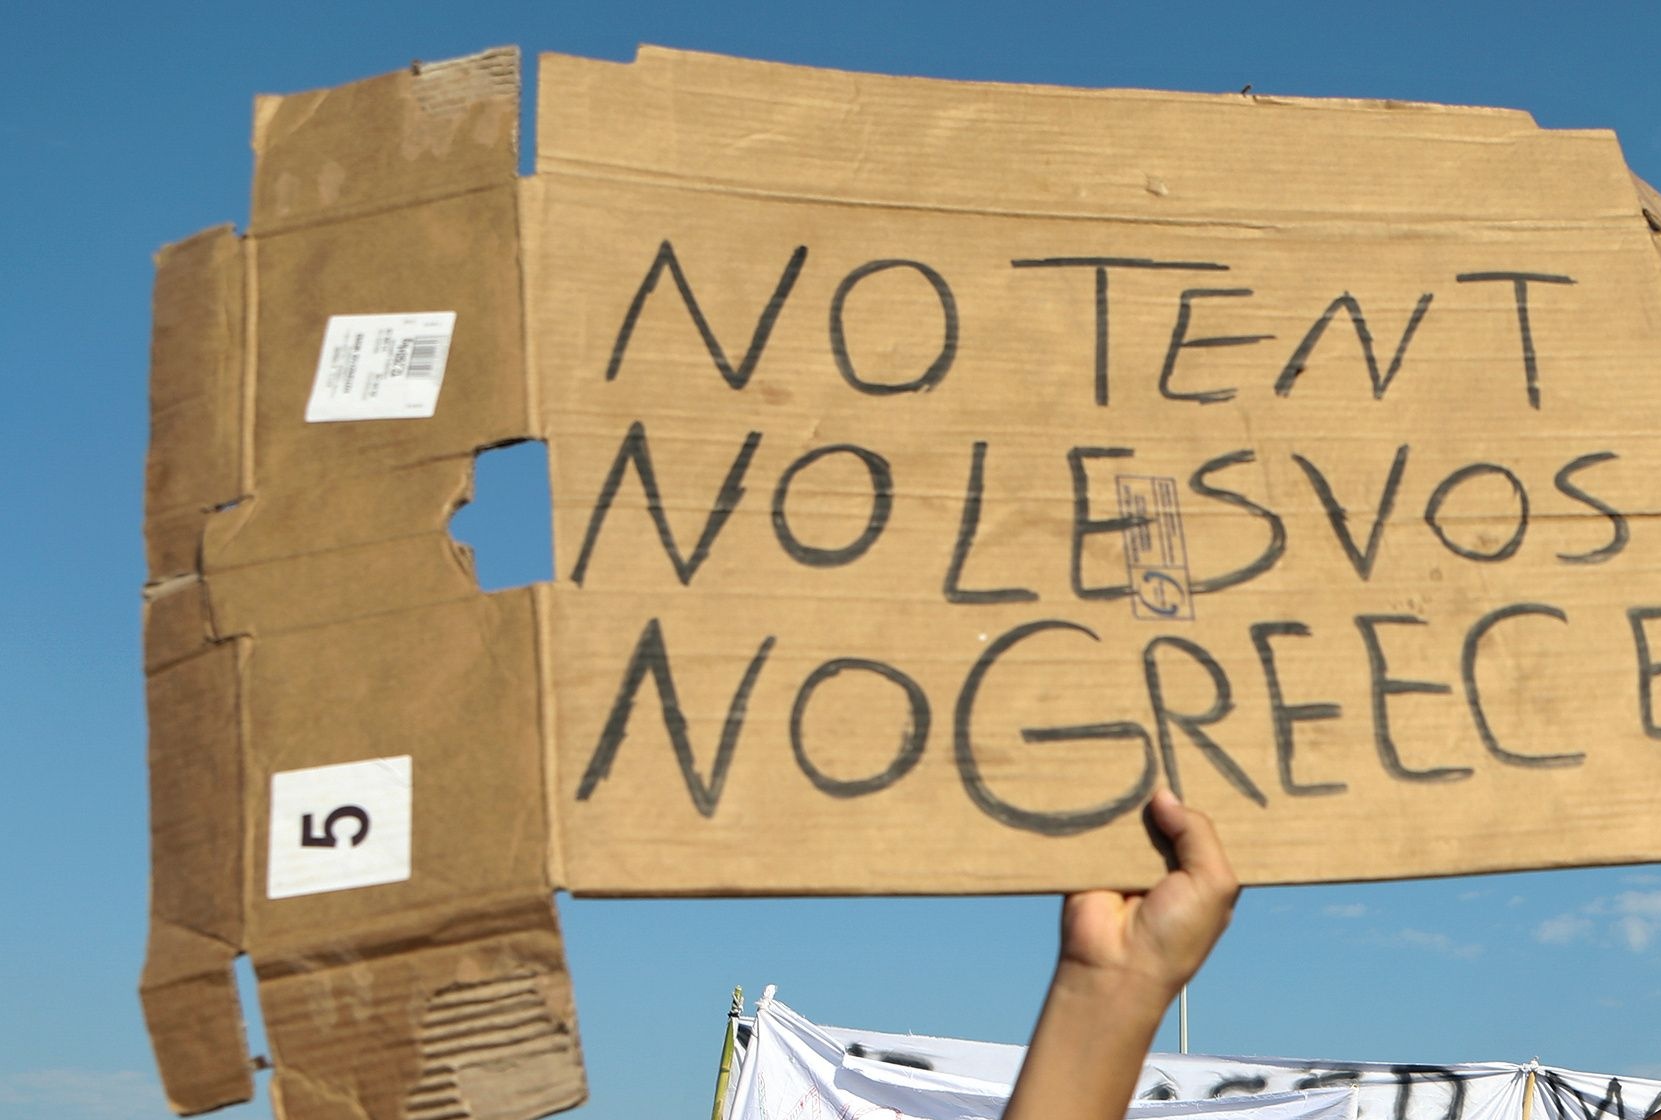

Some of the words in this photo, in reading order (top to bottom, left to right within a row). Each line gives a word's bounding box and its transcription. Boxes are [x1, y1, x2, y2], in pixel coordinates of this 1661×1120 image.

[605, 242, 960, 393] NO
[1011, 257, 1576, 409] TENT
[571, 422, 894, 585] NO
[943, 442, 1631, 602] LESVOS
[576, 619, 933, 817] NO
[302, 806, 370, 847] 5
